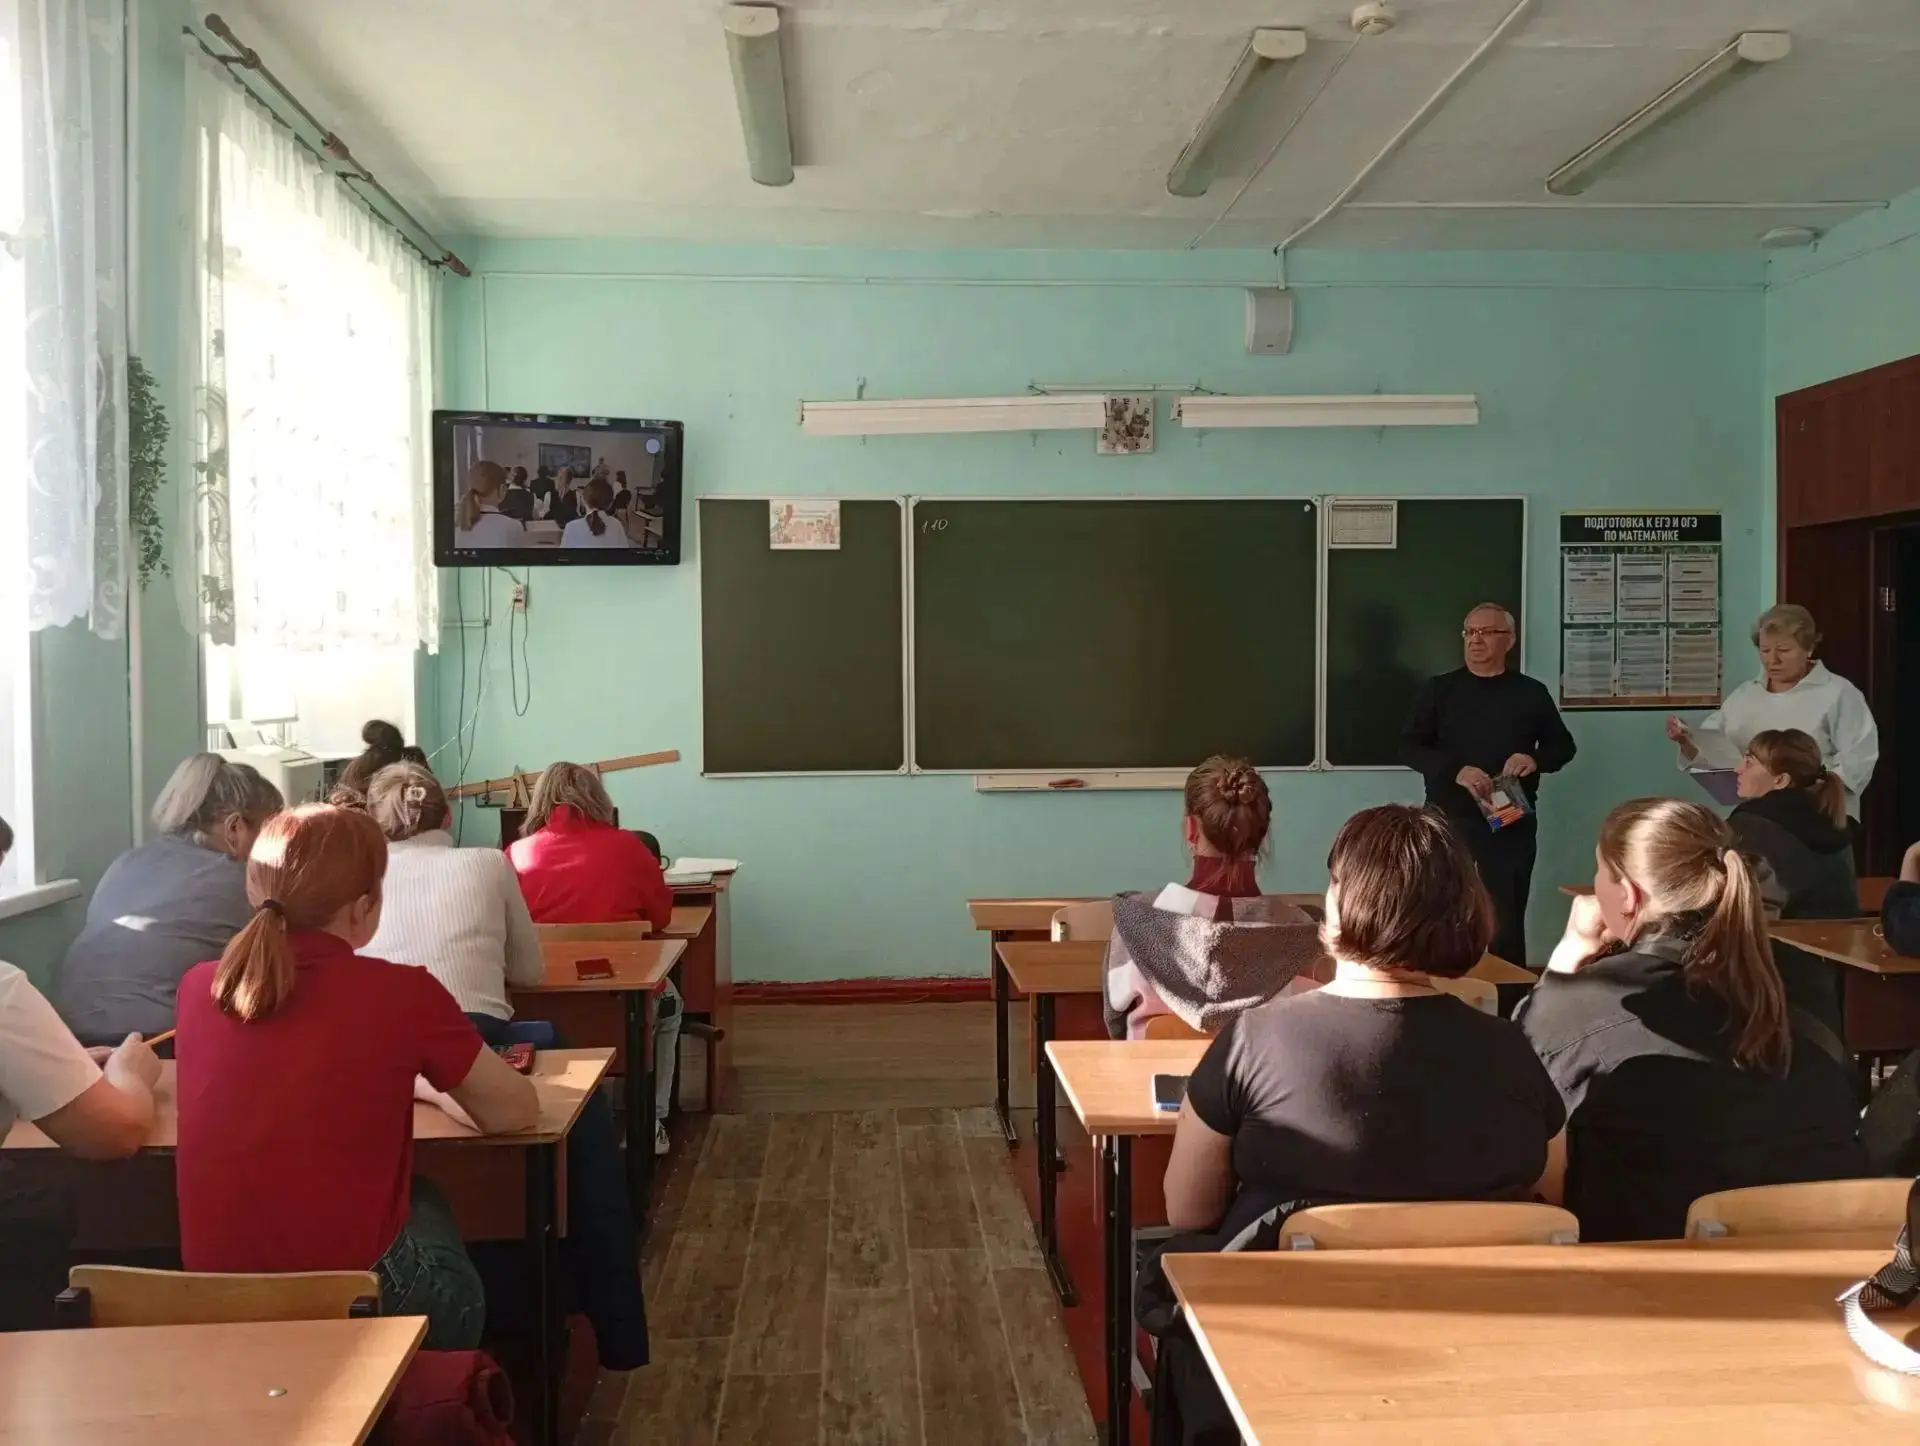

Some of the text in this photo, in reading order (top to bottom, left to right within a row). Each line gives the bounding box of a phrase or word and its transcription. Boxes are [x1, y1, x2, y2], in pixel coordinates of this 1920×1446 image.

[1584, 516, 1698, 530] ПОДГОТОВКА К ЕГЭ И ОГЭ
[1604, 530, 1679, 541] ПО МАТЕМАТИКЕ
